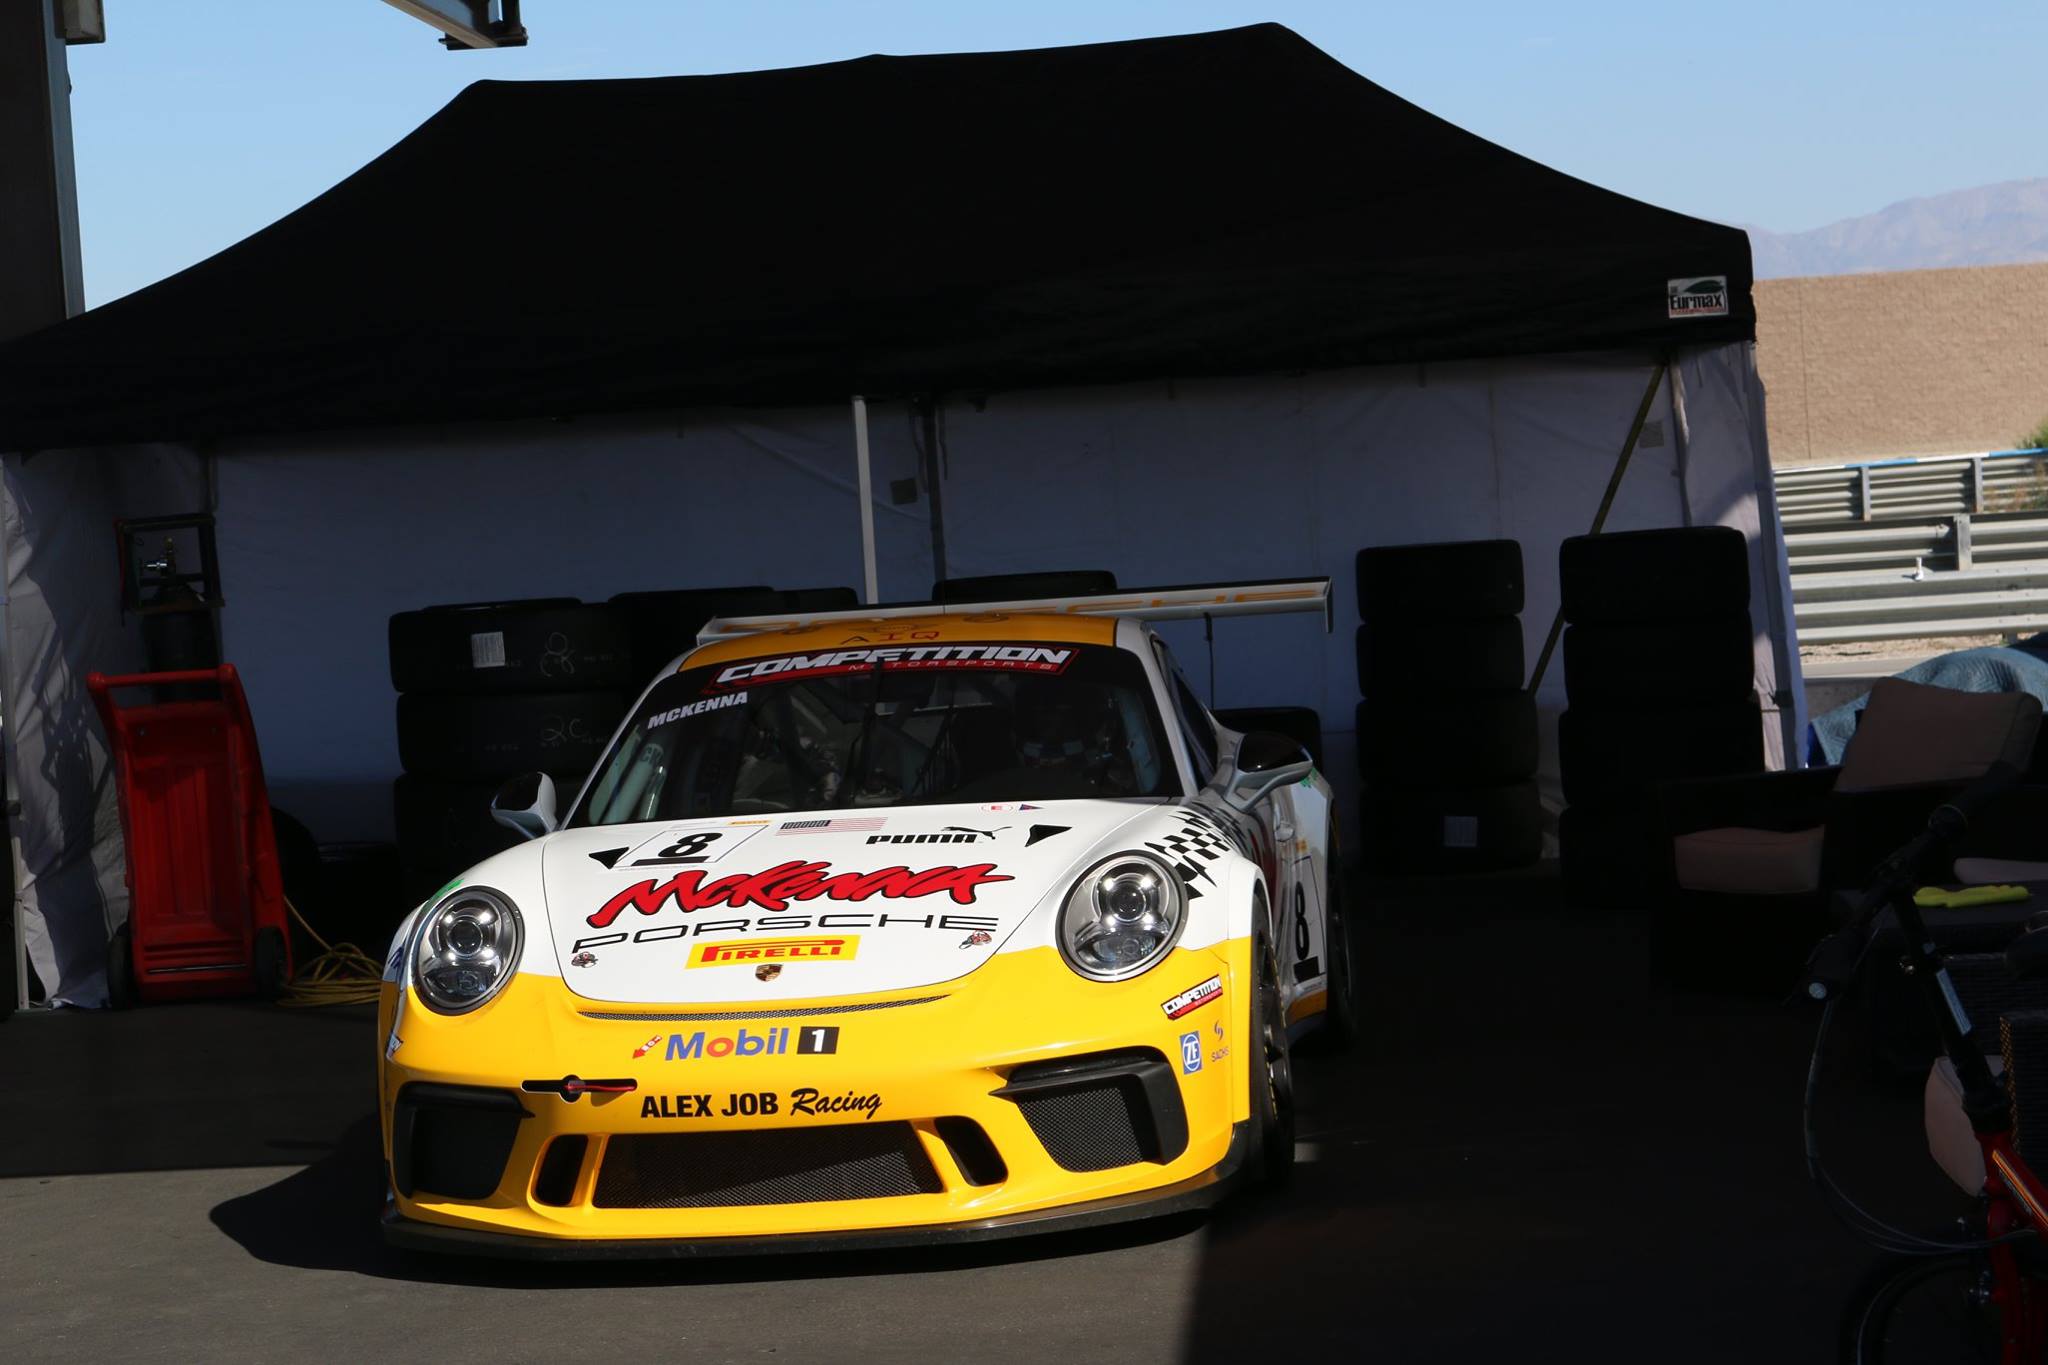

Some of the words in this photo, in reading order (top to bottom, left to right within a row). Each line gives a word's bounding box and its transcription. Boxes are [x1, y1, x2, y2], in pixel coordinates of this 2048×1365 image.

[1670, 294, 1722, 309] Eurmax
[716, 646, 1073, 684] COMPETITION
[847, 659, 1053, 672] MTORSPORTS
[648, 691, 749, 730] MCKENNA
[657, 832, 723, 857] 8
[572, 914, 999, 953] PORSCHE
[1295, 881, 1310, 961] 8
[700, 939, 846, 963] PIRELLI
[665, 1028, 790, 1061] Mobil
[1183, 1040, 1200, 1065] ZF
[640, 1094, 715, 1119] ALEX
[721, 1092, 779, 1118] JOB
[790, 1087, 883, 1120] Racing
